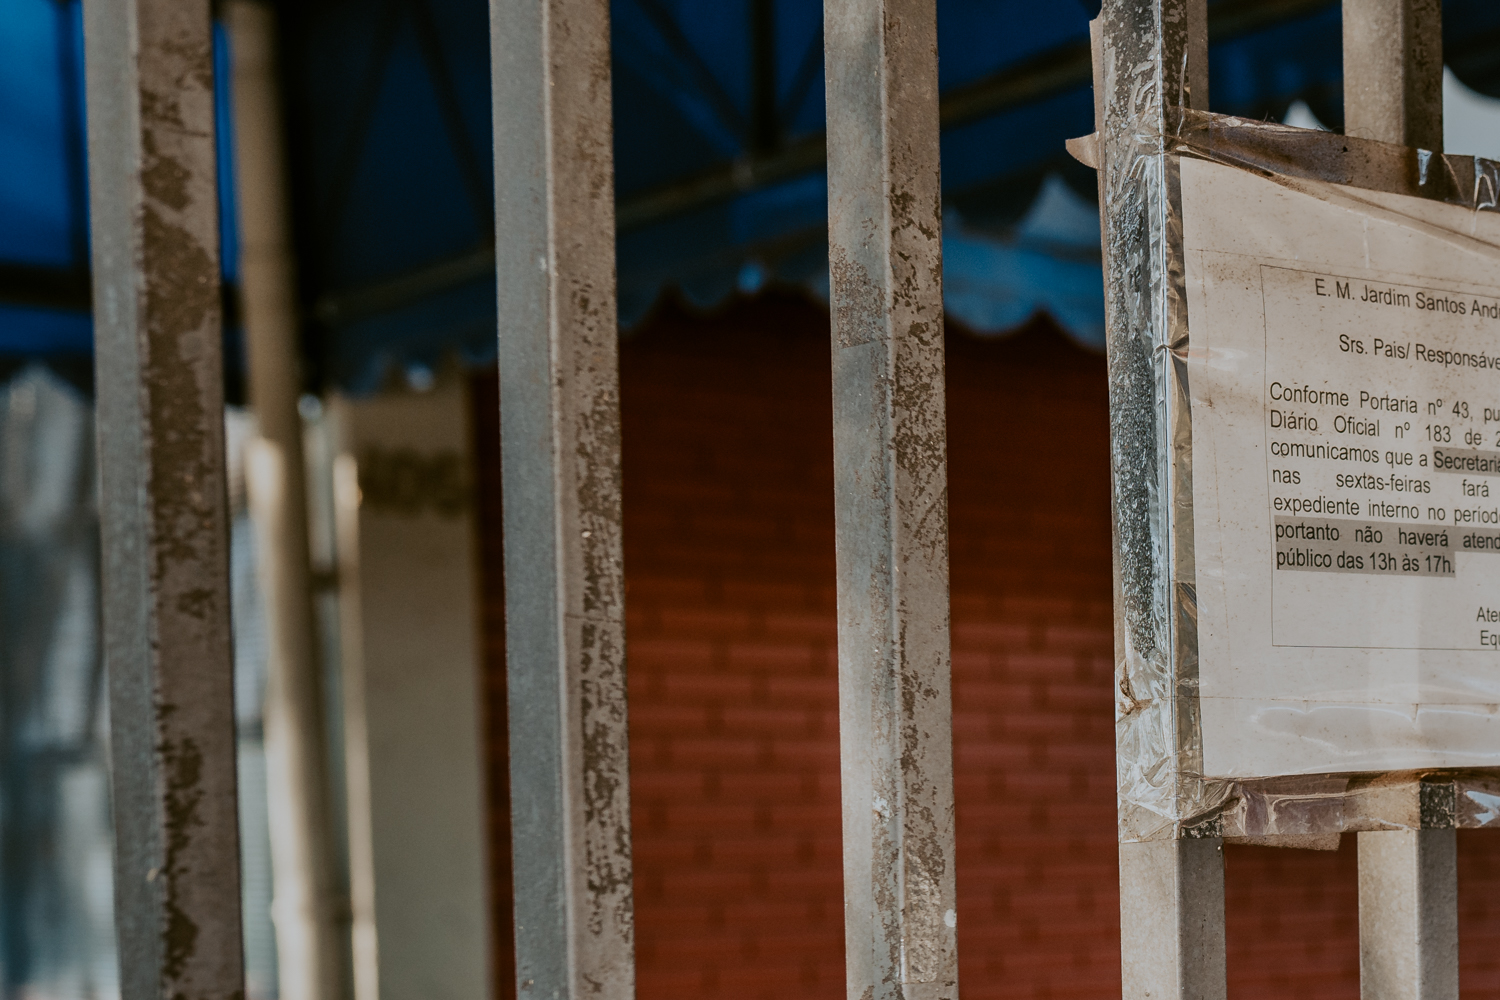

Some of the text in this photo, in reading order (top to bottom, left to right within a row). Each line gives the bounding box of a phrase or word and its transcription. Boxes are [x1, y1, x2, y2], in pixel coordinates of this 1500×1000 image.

[1315, 278, 1331, 297] E.
[1336, 281, 1355, 299] M.
[1361, 284, 1410, 308] Jardim
[1415, 292, 1466, 315] Santos
[1339, 334, 1368, 354] Srs.
[1374, 338, 1411, 359] Pais/
[1270, 381, 1349, 407] Conforme
[1360, 390, 1418, 414] Portaria
[1452, 401, 1474, 422] 43,
[1270, 409, 1318, 431] Diário
[1334, 415, 1380, 437] Oficial
[1425, 424, 1451, 443] 183
[1464, 428, 1482, 446] de
[1271, 441, 1380, 463] comunicamos
[1385, 450, 1413, 469] que
[1419, 453, 1428, 467] a
[1272, 469, 1301, 485] nas
[1336, 472, 1431, 494] sextas-feiras
[1462, 478, 1489, 498] fará
[1273, 495, 1360, 516] expediente
[1368, 499, 1420, 519] interno
[1428, 507, 1446, 521] no
[1275, 522, 1340, 542] portanto
[1355, 526, 1383, 543] não
[1398, 527, 1449, 548] haverá
[1276, 547, 1455, 574] público das 13h às 17h.
